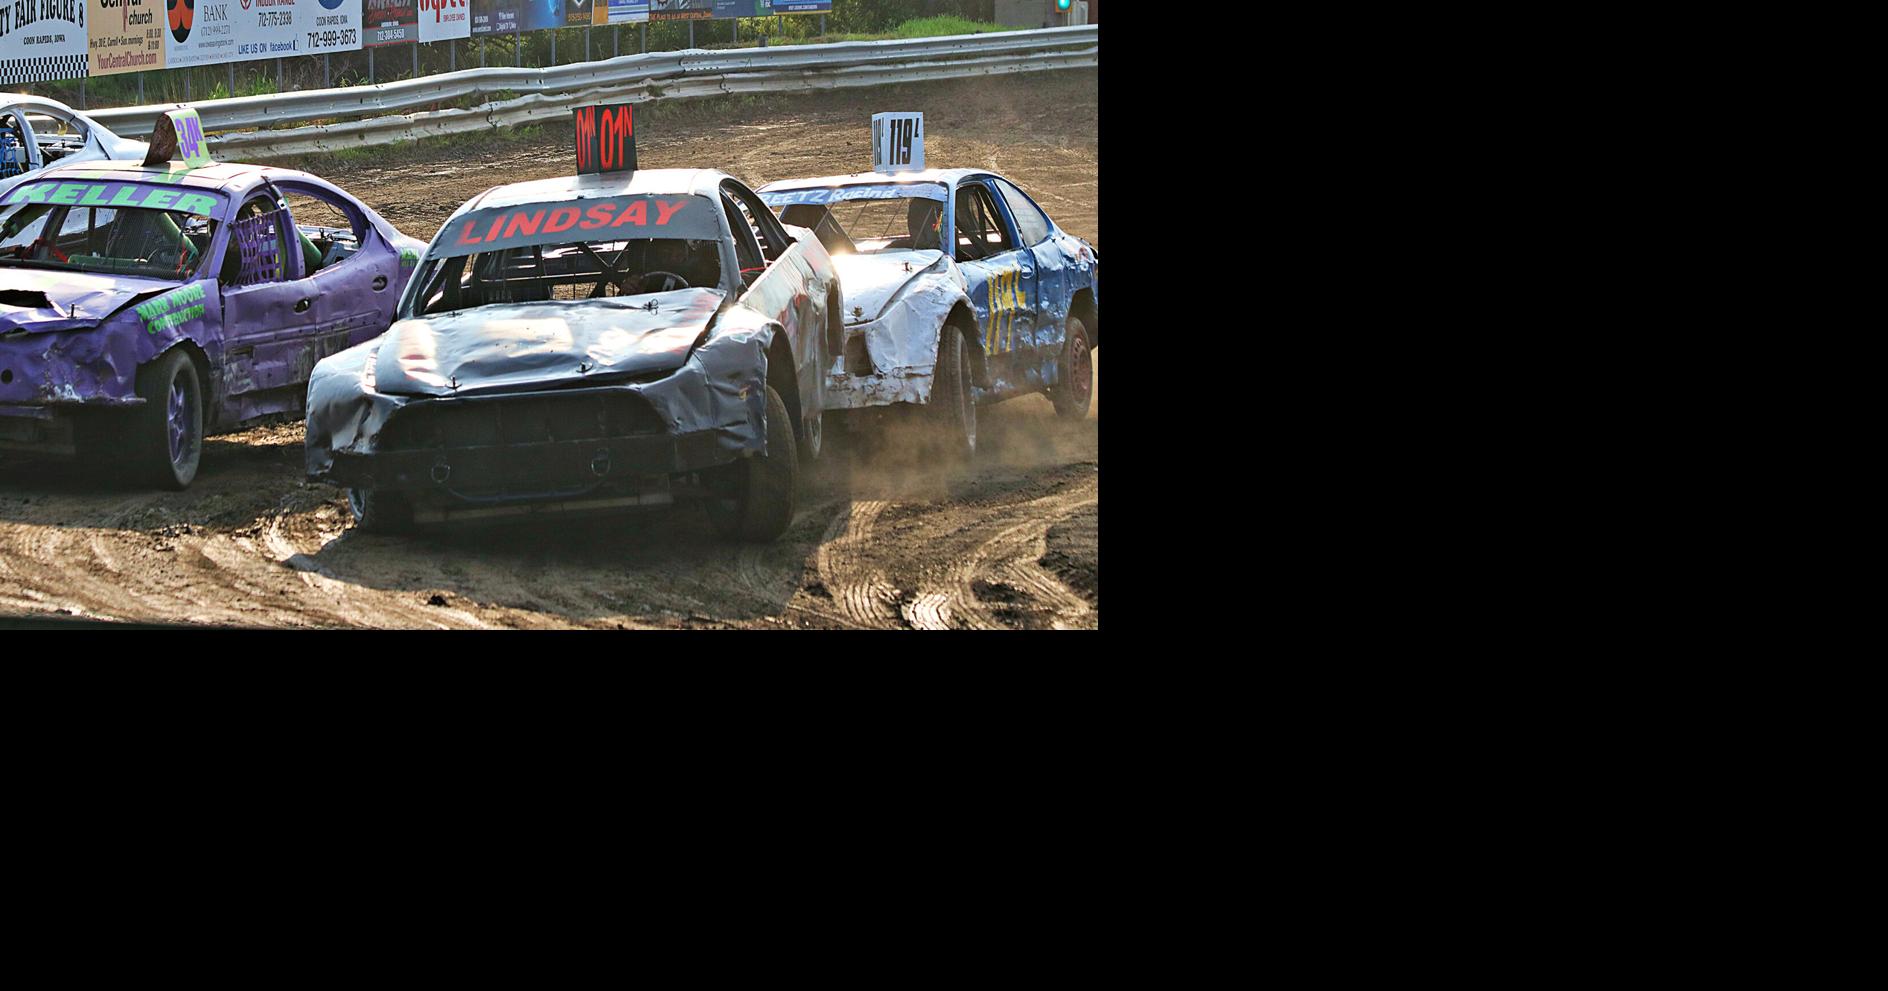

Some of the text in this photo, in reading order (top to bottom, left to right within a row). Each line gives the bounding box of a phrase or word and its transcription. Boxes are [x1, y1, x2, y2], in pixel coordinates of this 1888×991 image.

[15, 0, 37, 30] FAIR
[40, 0, 76, 24] FIGURE
[79, 2, 84, 29] 8
[128, 8, 153, 26] church
[203, 4, 228, 22] BANK
[316, 16, 327, 27] COON
[340, 14, 349, 24] IOWA
[23, 36, 35, 45] COON
[54, 34, 66, 43] IOWA
[238, 40, 293, 55] LIKE US ON facebook
[307, 28, 357, 49] 712-999-3673
[97, 50, 157, 70] YourCentralChurch.com
[7, 183, 219, 217] KELLER
[455, 200, 689, 247] LINDSAY
[170, 283, 206, 308] MOORE
